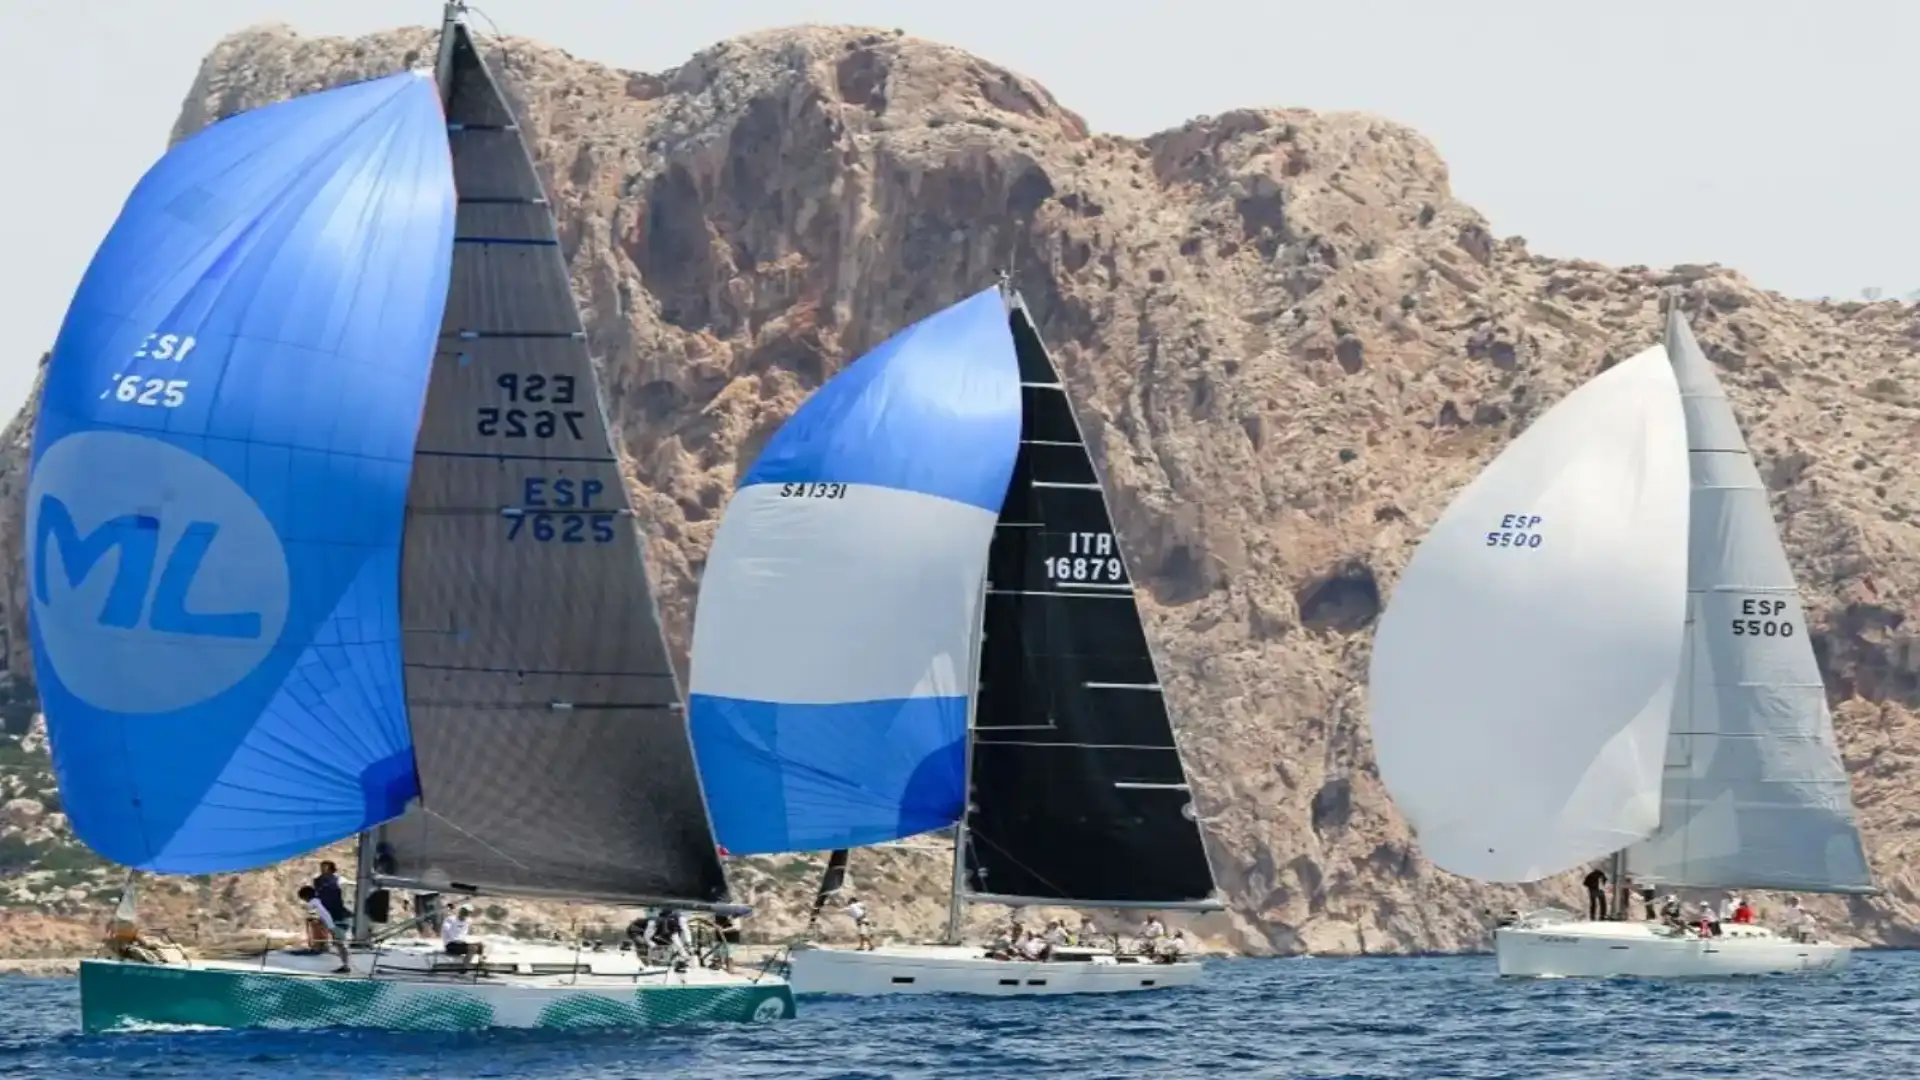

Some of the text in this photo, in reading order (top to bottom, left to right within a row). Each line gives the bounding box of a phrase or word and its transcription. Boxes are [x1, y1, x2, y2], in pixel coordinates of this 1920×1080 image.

[525, 478, 604, 508] ESP
[502, 514, 615, 543] 7625
[1501, 514, 1542, 529] ESP
[1070, 532, 1112, 555] ITA
[1486, 532, 1543, 548] 5500
[35, 493, 262, 639] ML
[1044, 557, 1121, 580] 16879
[1743, 599, 1787, 616] ESP
[1732, 619, 1793, 637] 5500
